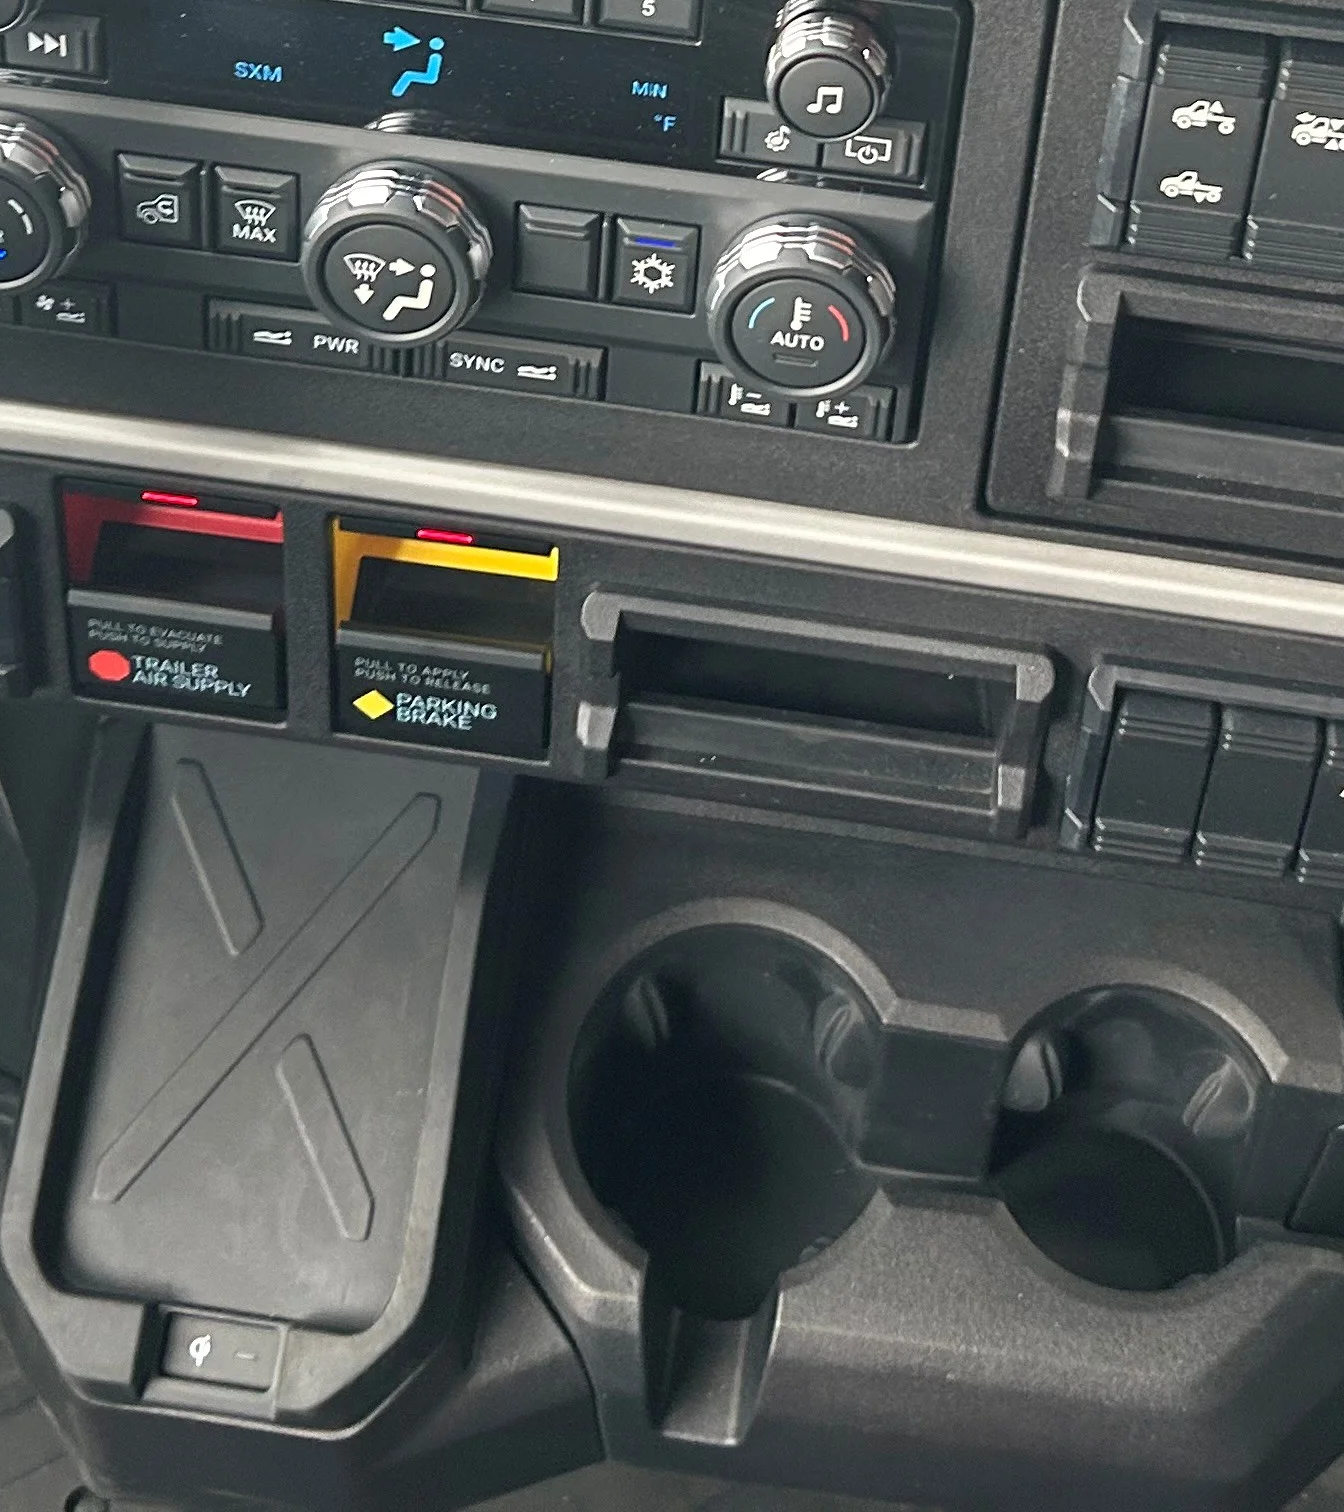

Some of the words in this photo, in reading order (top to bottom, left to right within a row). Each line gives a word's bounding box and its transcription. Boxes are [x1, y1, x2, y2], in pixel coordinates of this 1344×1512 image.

[642, 0, 655, 16] 5
[235, 62, 281, 82] SXM
[632, 81, 667, 98] MIN
[233, 223, 276, 243] MAX
[314, 335, 359, 353] PWR
[770, 329, 824, 350] AUTO
[450, 353, 504, 373] SYNC
[132, 655, 218, 678] TRAILER
[355, 656, 391, 669] PULL
[398, 662, 418, 674] TO
[422, 665, 470, 681] APPLY
[132, 670, 169, 686] AIR
[172, 675, 252, 698] SUPPLY
[355, 668, 396, 682] PUSH
[402, 674, 421, 686] TO
[424, 677, 492, 695] RELEASE
[396, 693, 498, 720] PARKING
[396, 707, 473, 731] BRAKE
